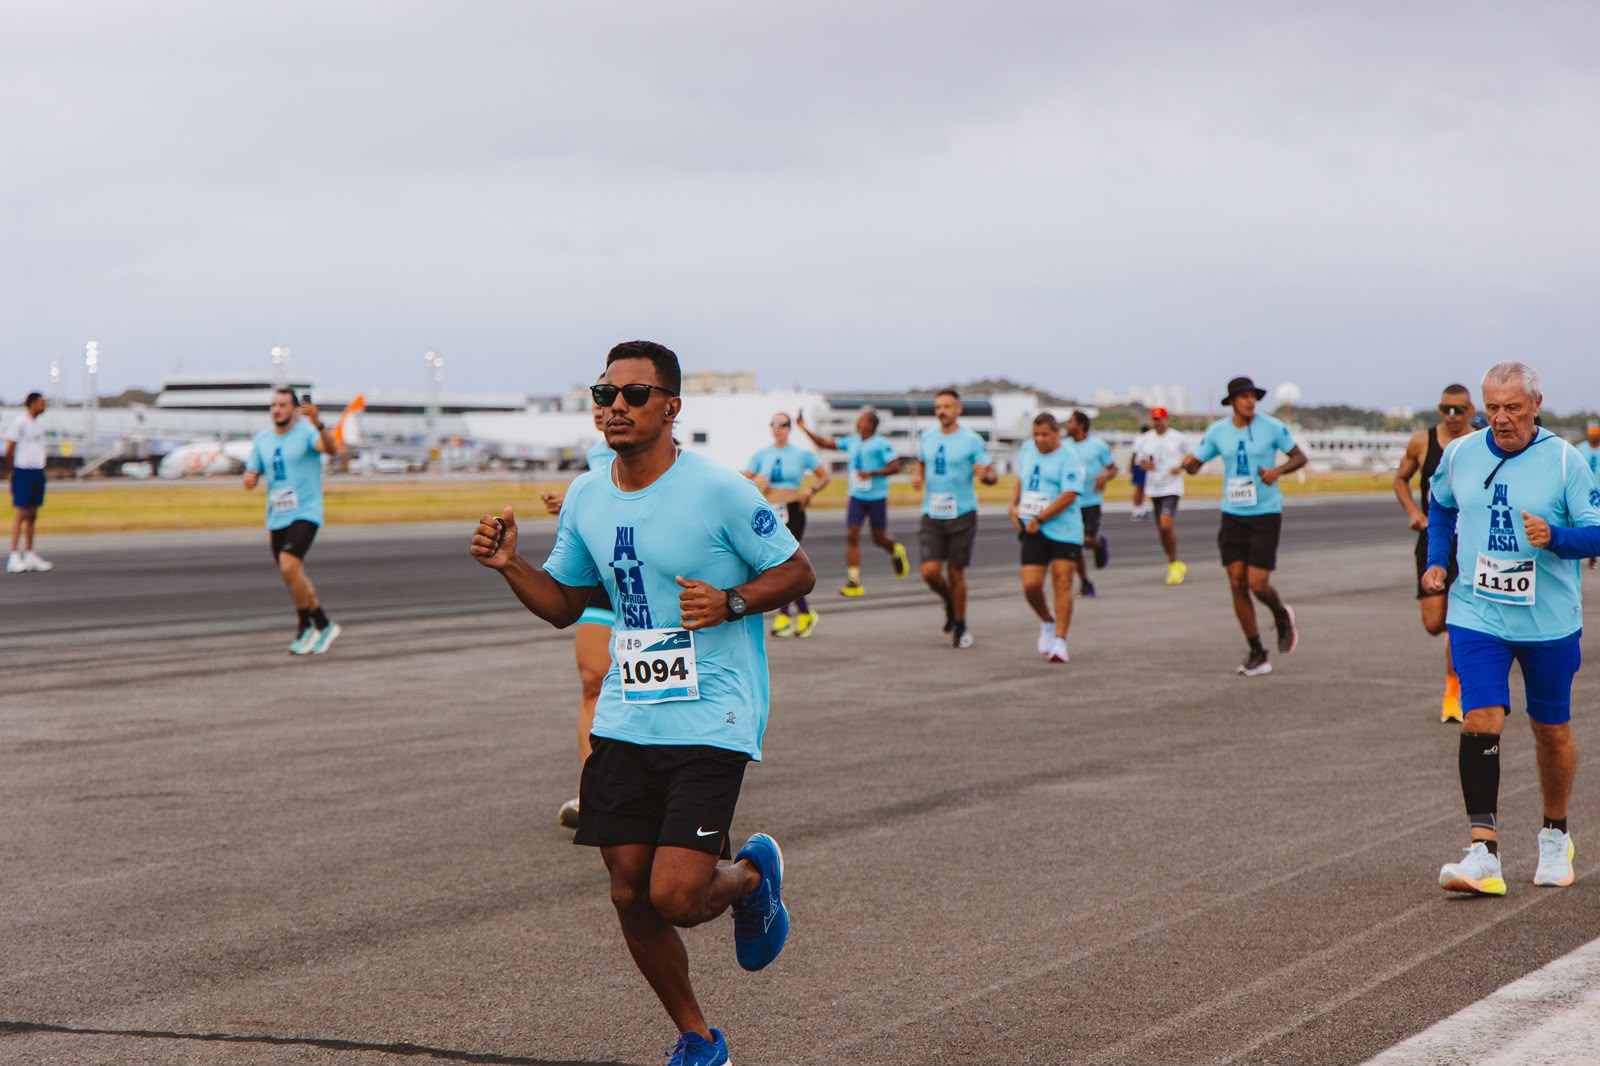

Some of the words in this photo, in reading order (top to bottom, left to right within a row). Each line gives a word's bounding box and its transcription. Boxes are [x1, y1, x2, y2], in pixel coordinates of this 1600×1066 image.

[1494, 483, 1507, 497] XLI
[615, 526, 634, 546] XLI
[1488, 534, 1519, 552] ASA
[1478, 572, 1530, 592] 1110
[619, 592, 648, 605] ORRIDA
[623, 656, 689, 684] 1094
